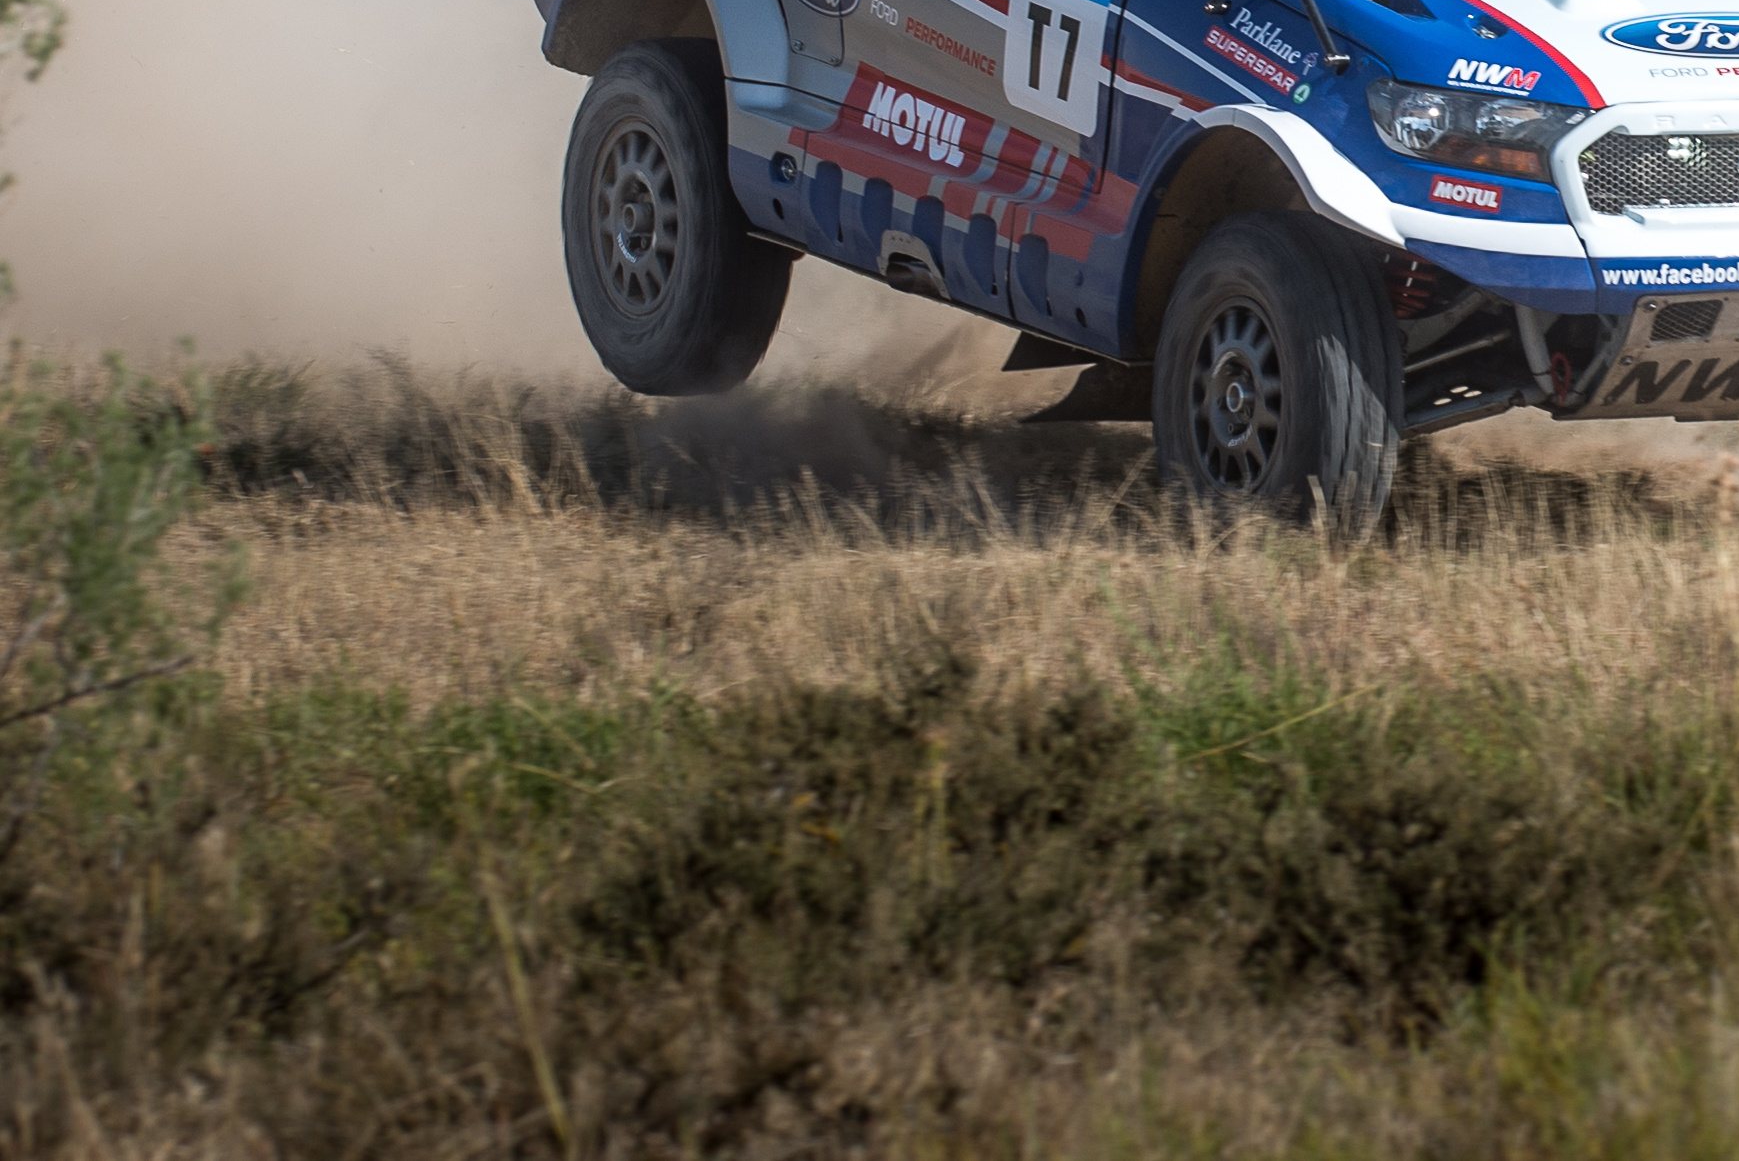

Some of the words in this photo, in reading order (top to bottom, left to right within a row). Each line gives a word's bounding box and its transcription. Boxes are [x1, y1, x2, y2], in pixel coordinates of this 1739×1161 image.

[905, 17, 996, 77] PERFORMANCE
[1028, 1, 1081, 102] T7
[1206, 30, 1296, 92] SUPERSPAR
[1230, 7, 1301, 64] Parklane
[1448, 58, 1542, 91] NWM
[1649, 67, 1708, 78] FORD
[862, 81, 966, 167] MOTUL
[1433, 181, 1498, 208] MOTUL
